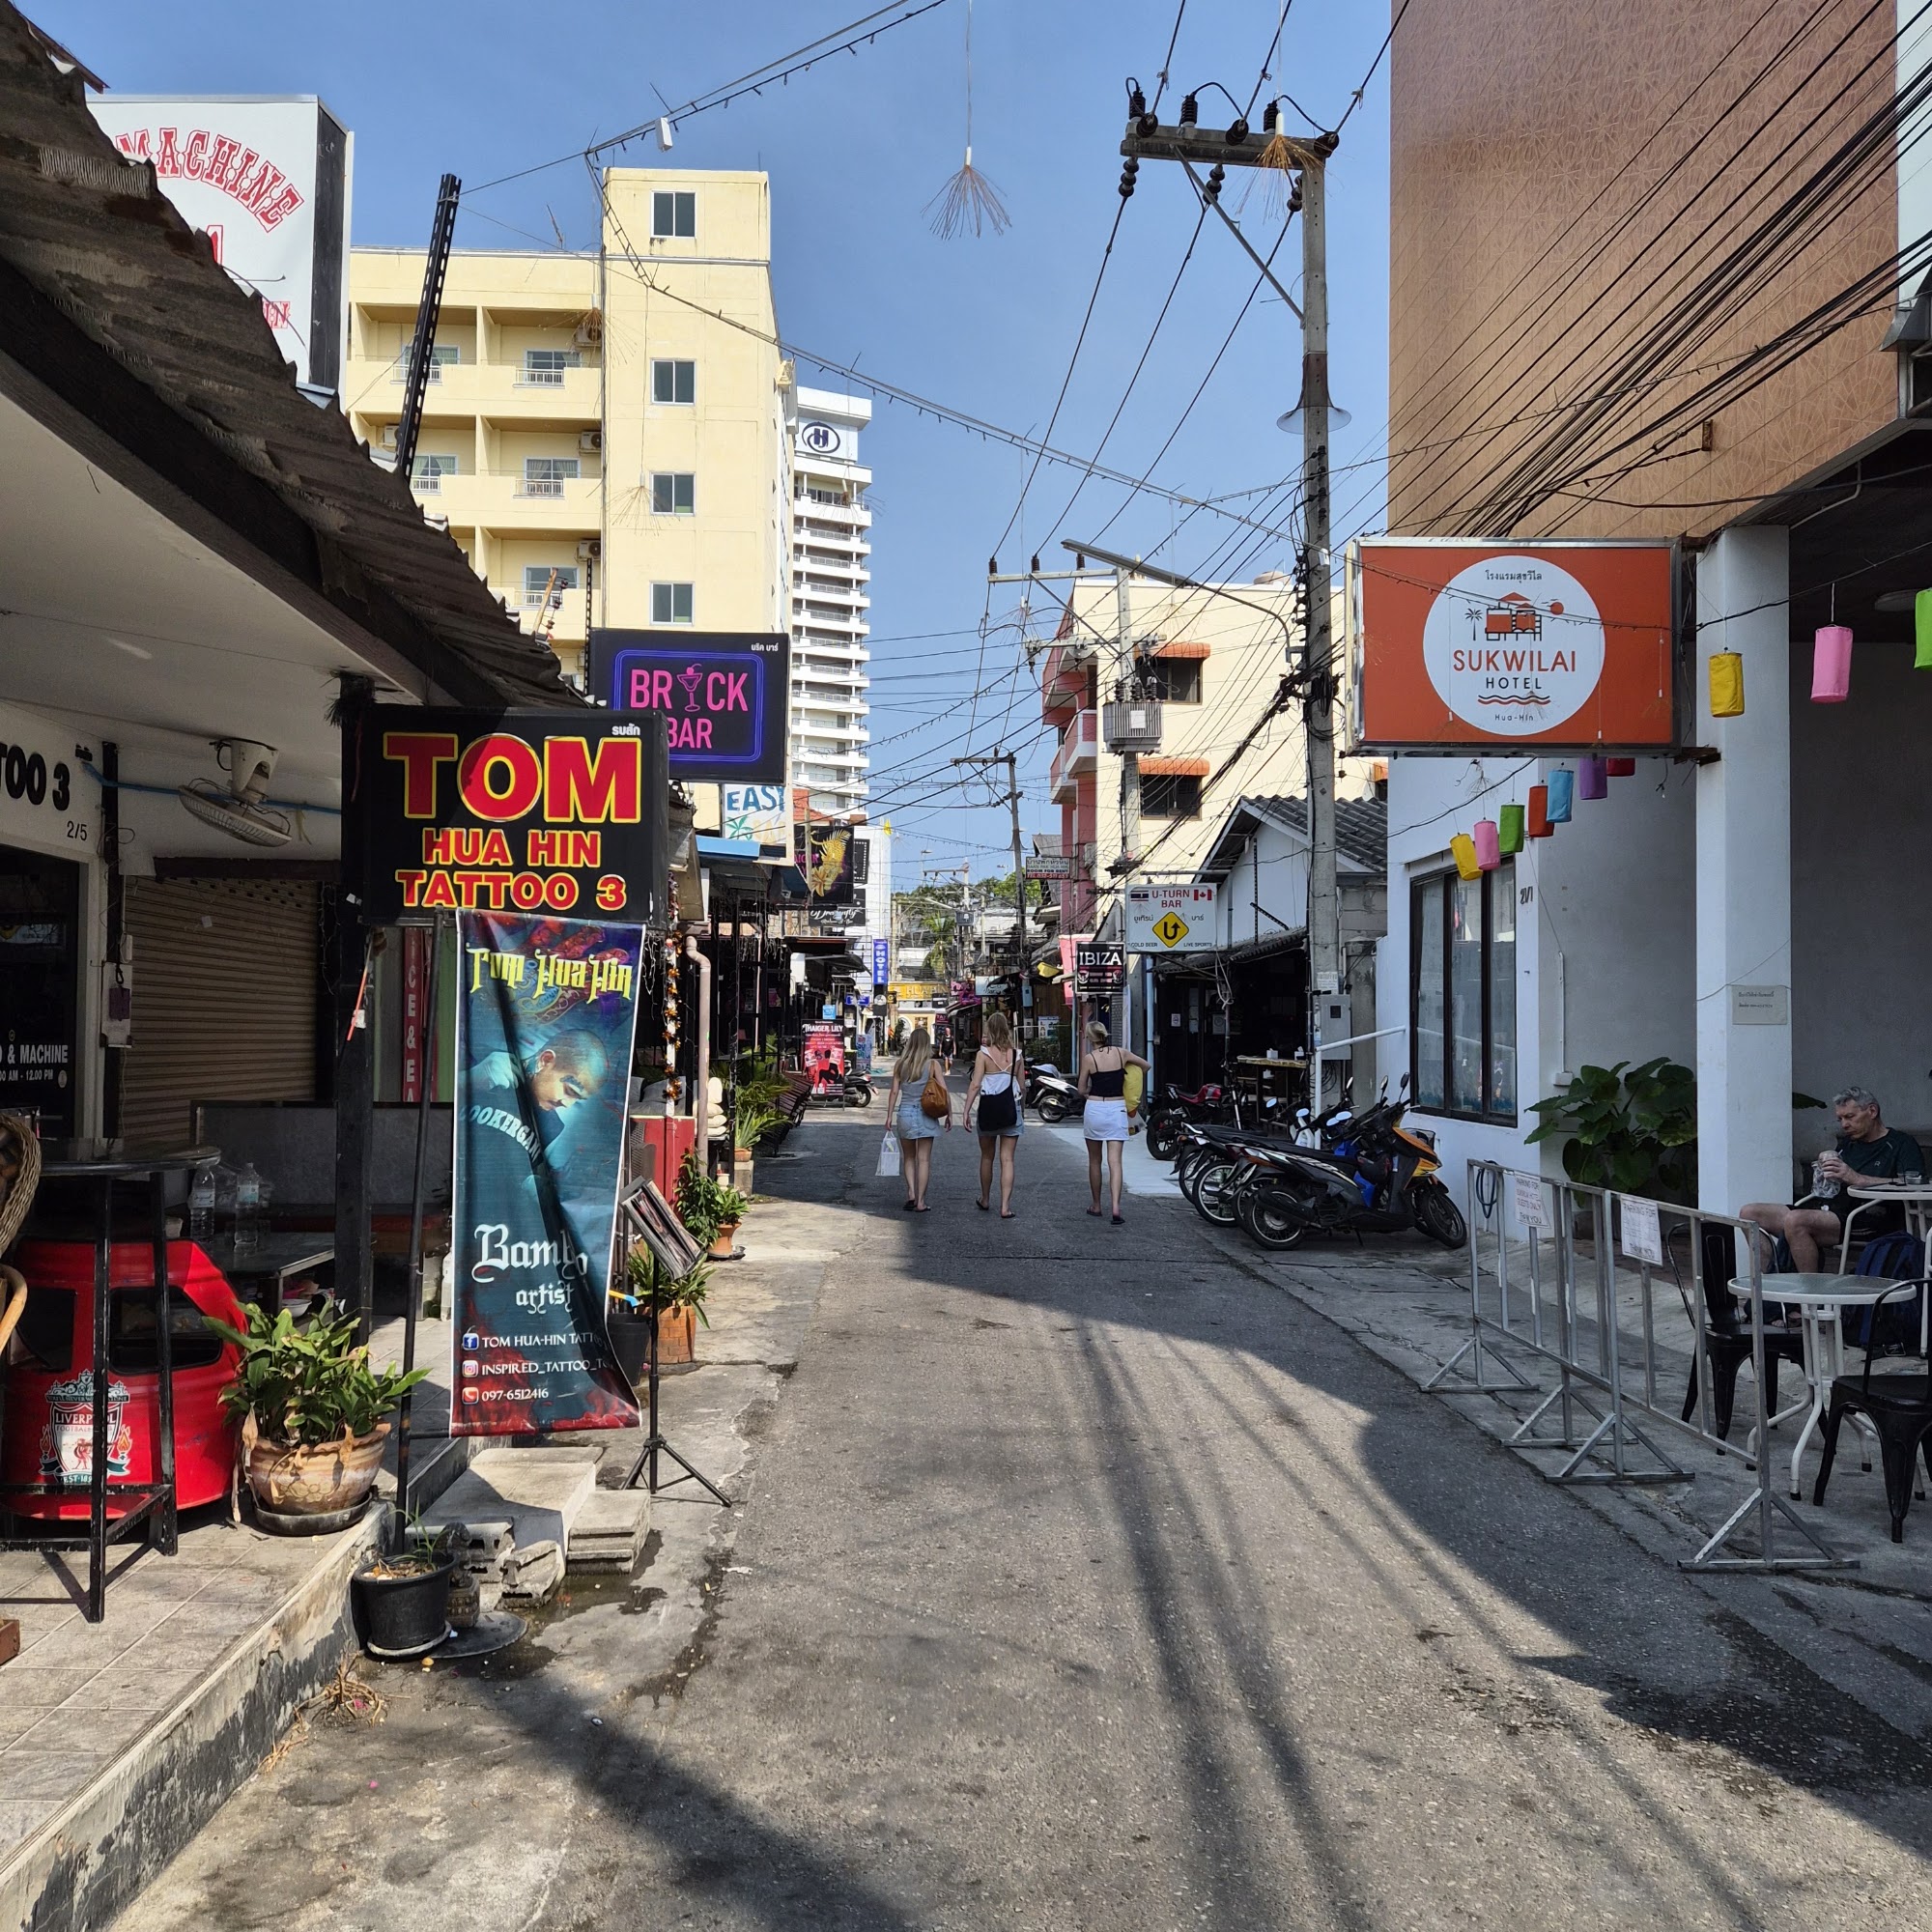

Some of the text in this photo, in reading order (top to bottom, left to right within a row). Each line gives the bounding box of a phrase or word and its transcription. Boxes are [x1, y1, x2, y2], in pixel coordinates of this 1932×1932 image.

[116, 127, 304, 233] MACHINE
[1485, 570, 1543, 583] โรงแรมสุขวิไล
[1453, 649, 1577, 672] SUKWILAI
[1486, 677, 1543, 690] HOTEL
[52, 763, 71, 811] 3
[383, 731, 642, 824] TOM
[67, 820, 88, 841] 2/5
[422, 827, 601, 868] HUA HIN
[395, 869, 627, 912] TATTOO 3
[1151, 890, 1190, 898] U-TURN
[1161, 899, 1181, 908] BAR
[1079, 952, 1122, 965] IBIZA
[20, 1044, 69, 1064] MACHINE
[8, 1069, 18, 1081] AM
[43, 1068, 53, 1080] PM
[516, 1281, 575, 1315] artist
[482, 1336, 511, 1349] TOM
[514, 1333, 566, 1347] HUA-HIN
[482, 1388, 549, 1402] 097-6512416
